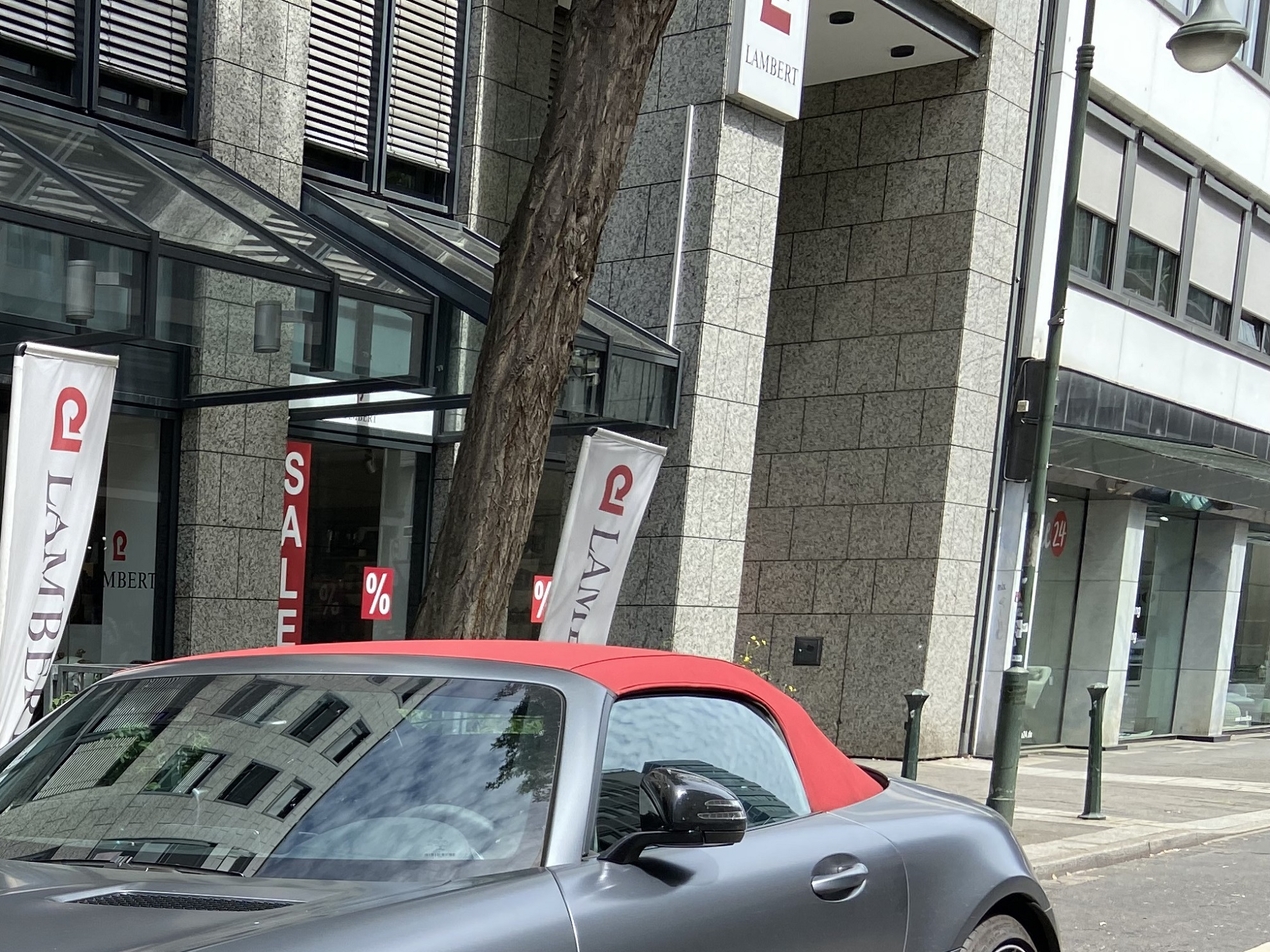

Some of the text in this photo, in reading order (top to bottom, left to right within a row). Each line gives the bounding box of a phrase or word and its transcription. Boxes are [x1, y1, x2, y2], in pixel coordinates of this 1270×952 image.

[745, 43, 799, 86] LAMBERT
[12, 469, 73, 740] LAMBER
[277, 451, 305, 646] SALE
